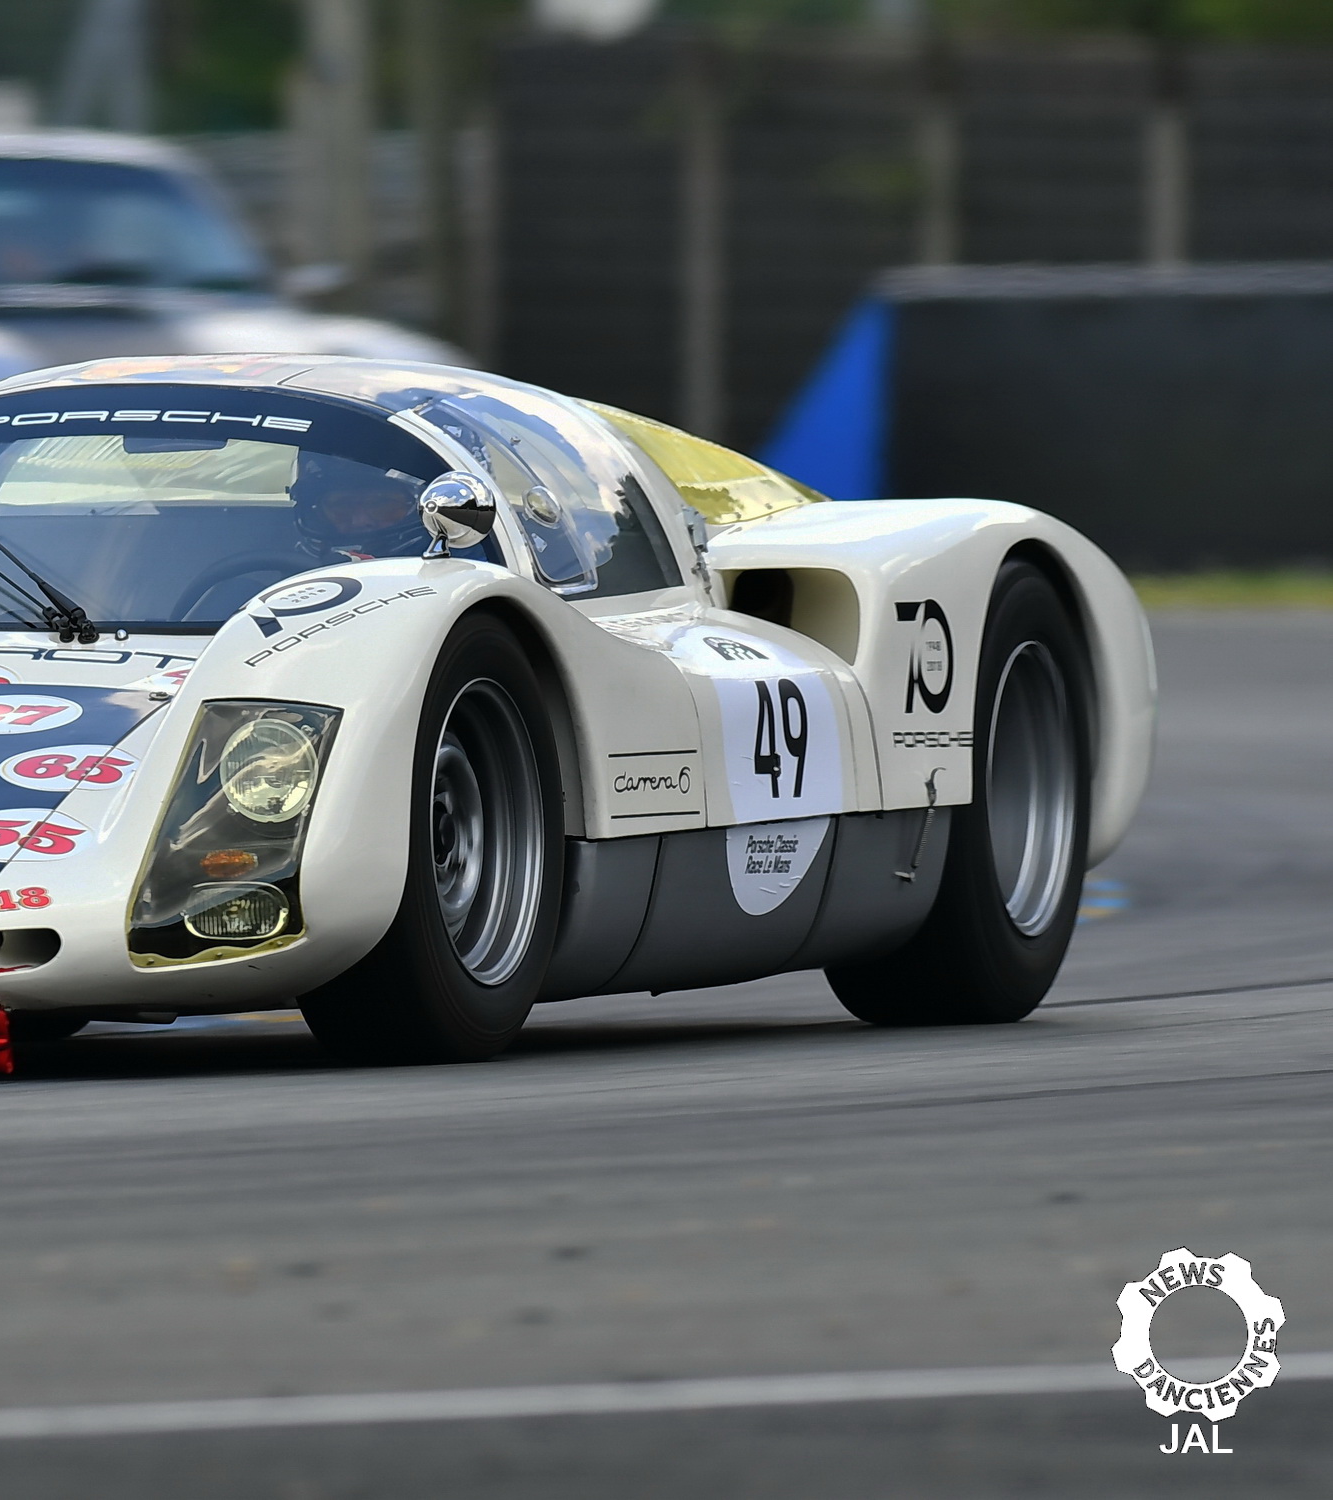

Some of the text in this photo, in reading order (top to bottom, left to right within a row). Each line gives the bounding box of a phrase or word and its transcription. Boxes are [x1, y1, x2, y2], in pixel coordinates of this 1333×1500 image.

[243, 585, 438, 668] PORSCHE
[893, 598, 954, 714] 70
[754, 678, 808, 799] 49
[892, 731, 974, 748] PORSCHE
[12, 753, 135, 785] 65
[613, 766, 691, 794] Carrera 6
[745, 834, 799, 854] Porsche Classic
[745, 855, 792, 874] Race Le Mans
